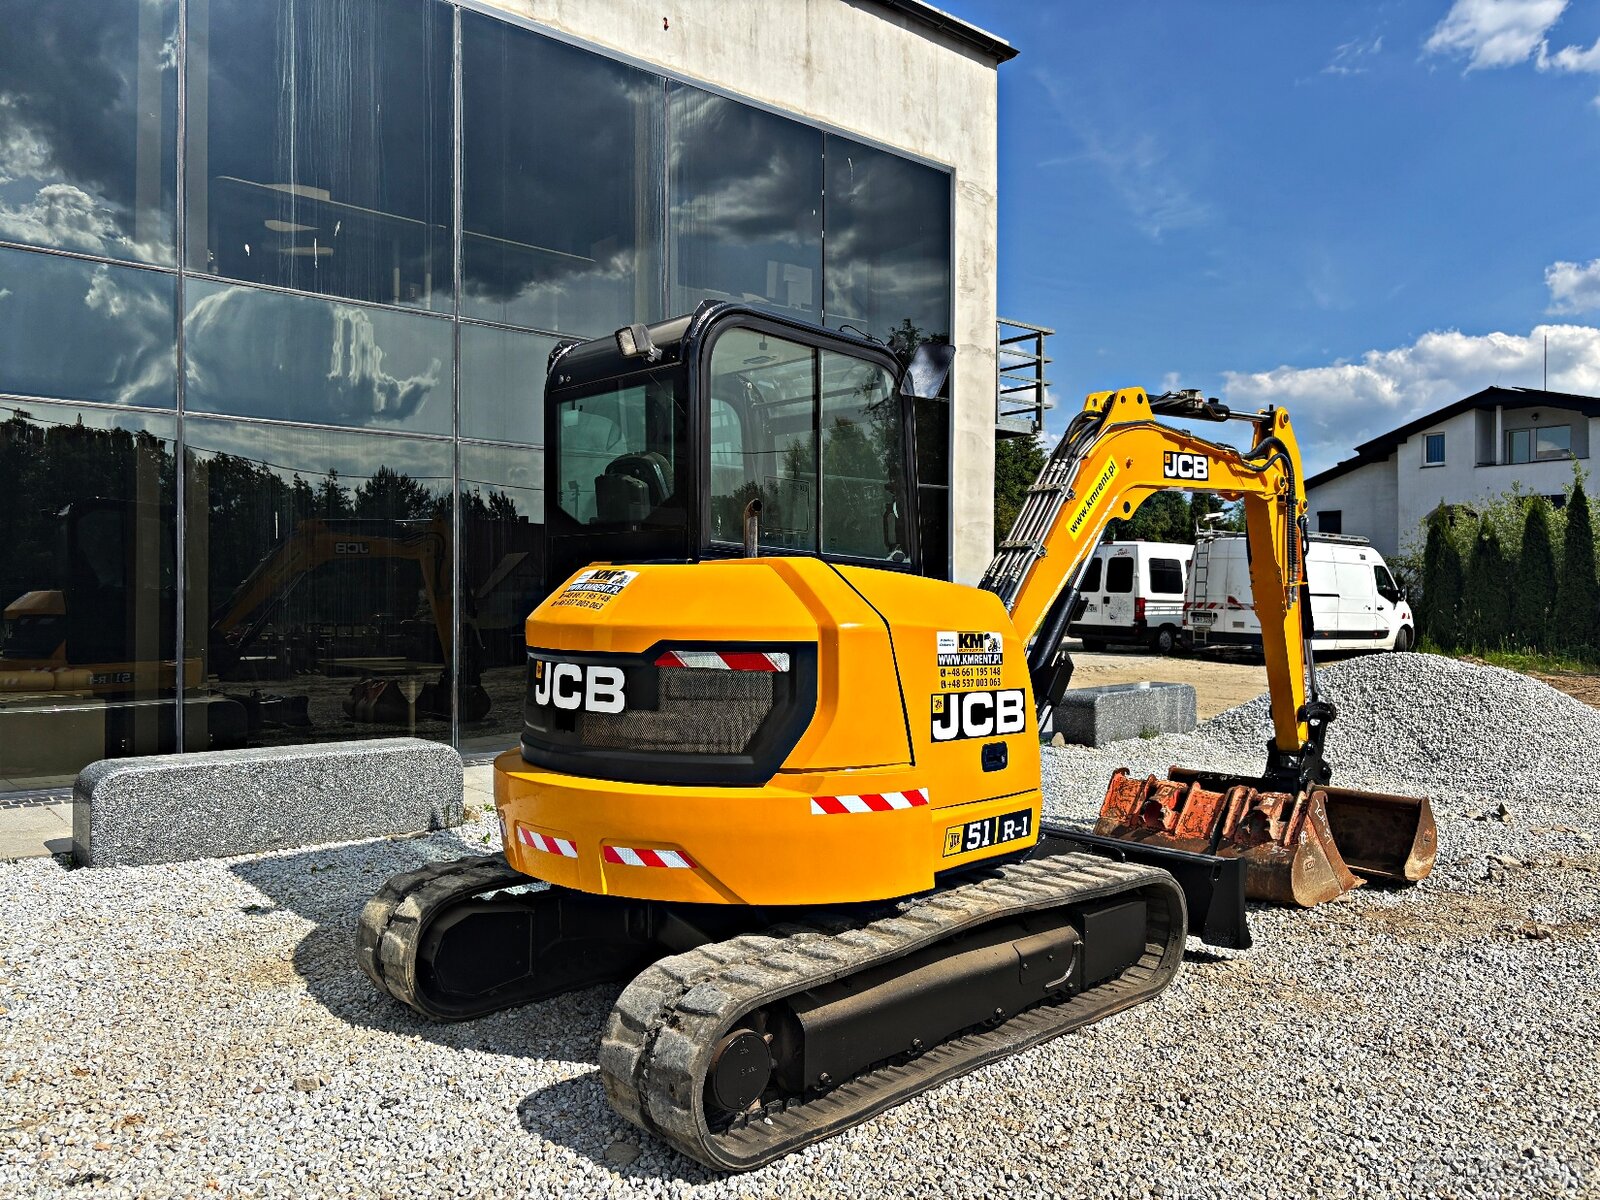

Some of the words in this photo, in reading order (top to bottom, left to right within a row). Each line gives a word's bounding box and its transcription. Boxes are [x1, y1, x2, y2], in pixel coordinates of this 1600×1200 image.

[1165, 453, 1208, 479] JCB
[1070, 460, 1116, 533] www.kmrent.pl
[589, 570, 617, 580] KM
[958, 633, 984, 649] KM
[938, 654, 1002, 665] WWW.KMRENT.PL
[947, 668, 960, 677] +48
[962, 668, 973, 677] 661
[976, 667, 988, 676] 195
[990, 667, 1001, 676] 148
[535, 661, 626, 714] JCB
[948, 680, 961, 688] +48
[962, 679, 974, 687] 537
[976, 678, 988, 687] 003
[990, 678, 1001, 686] 063
[932, 690, 1025, 740] JCB
[966, 820, 991, 850] 51
[1002, 816, 1029, 842] R-1
